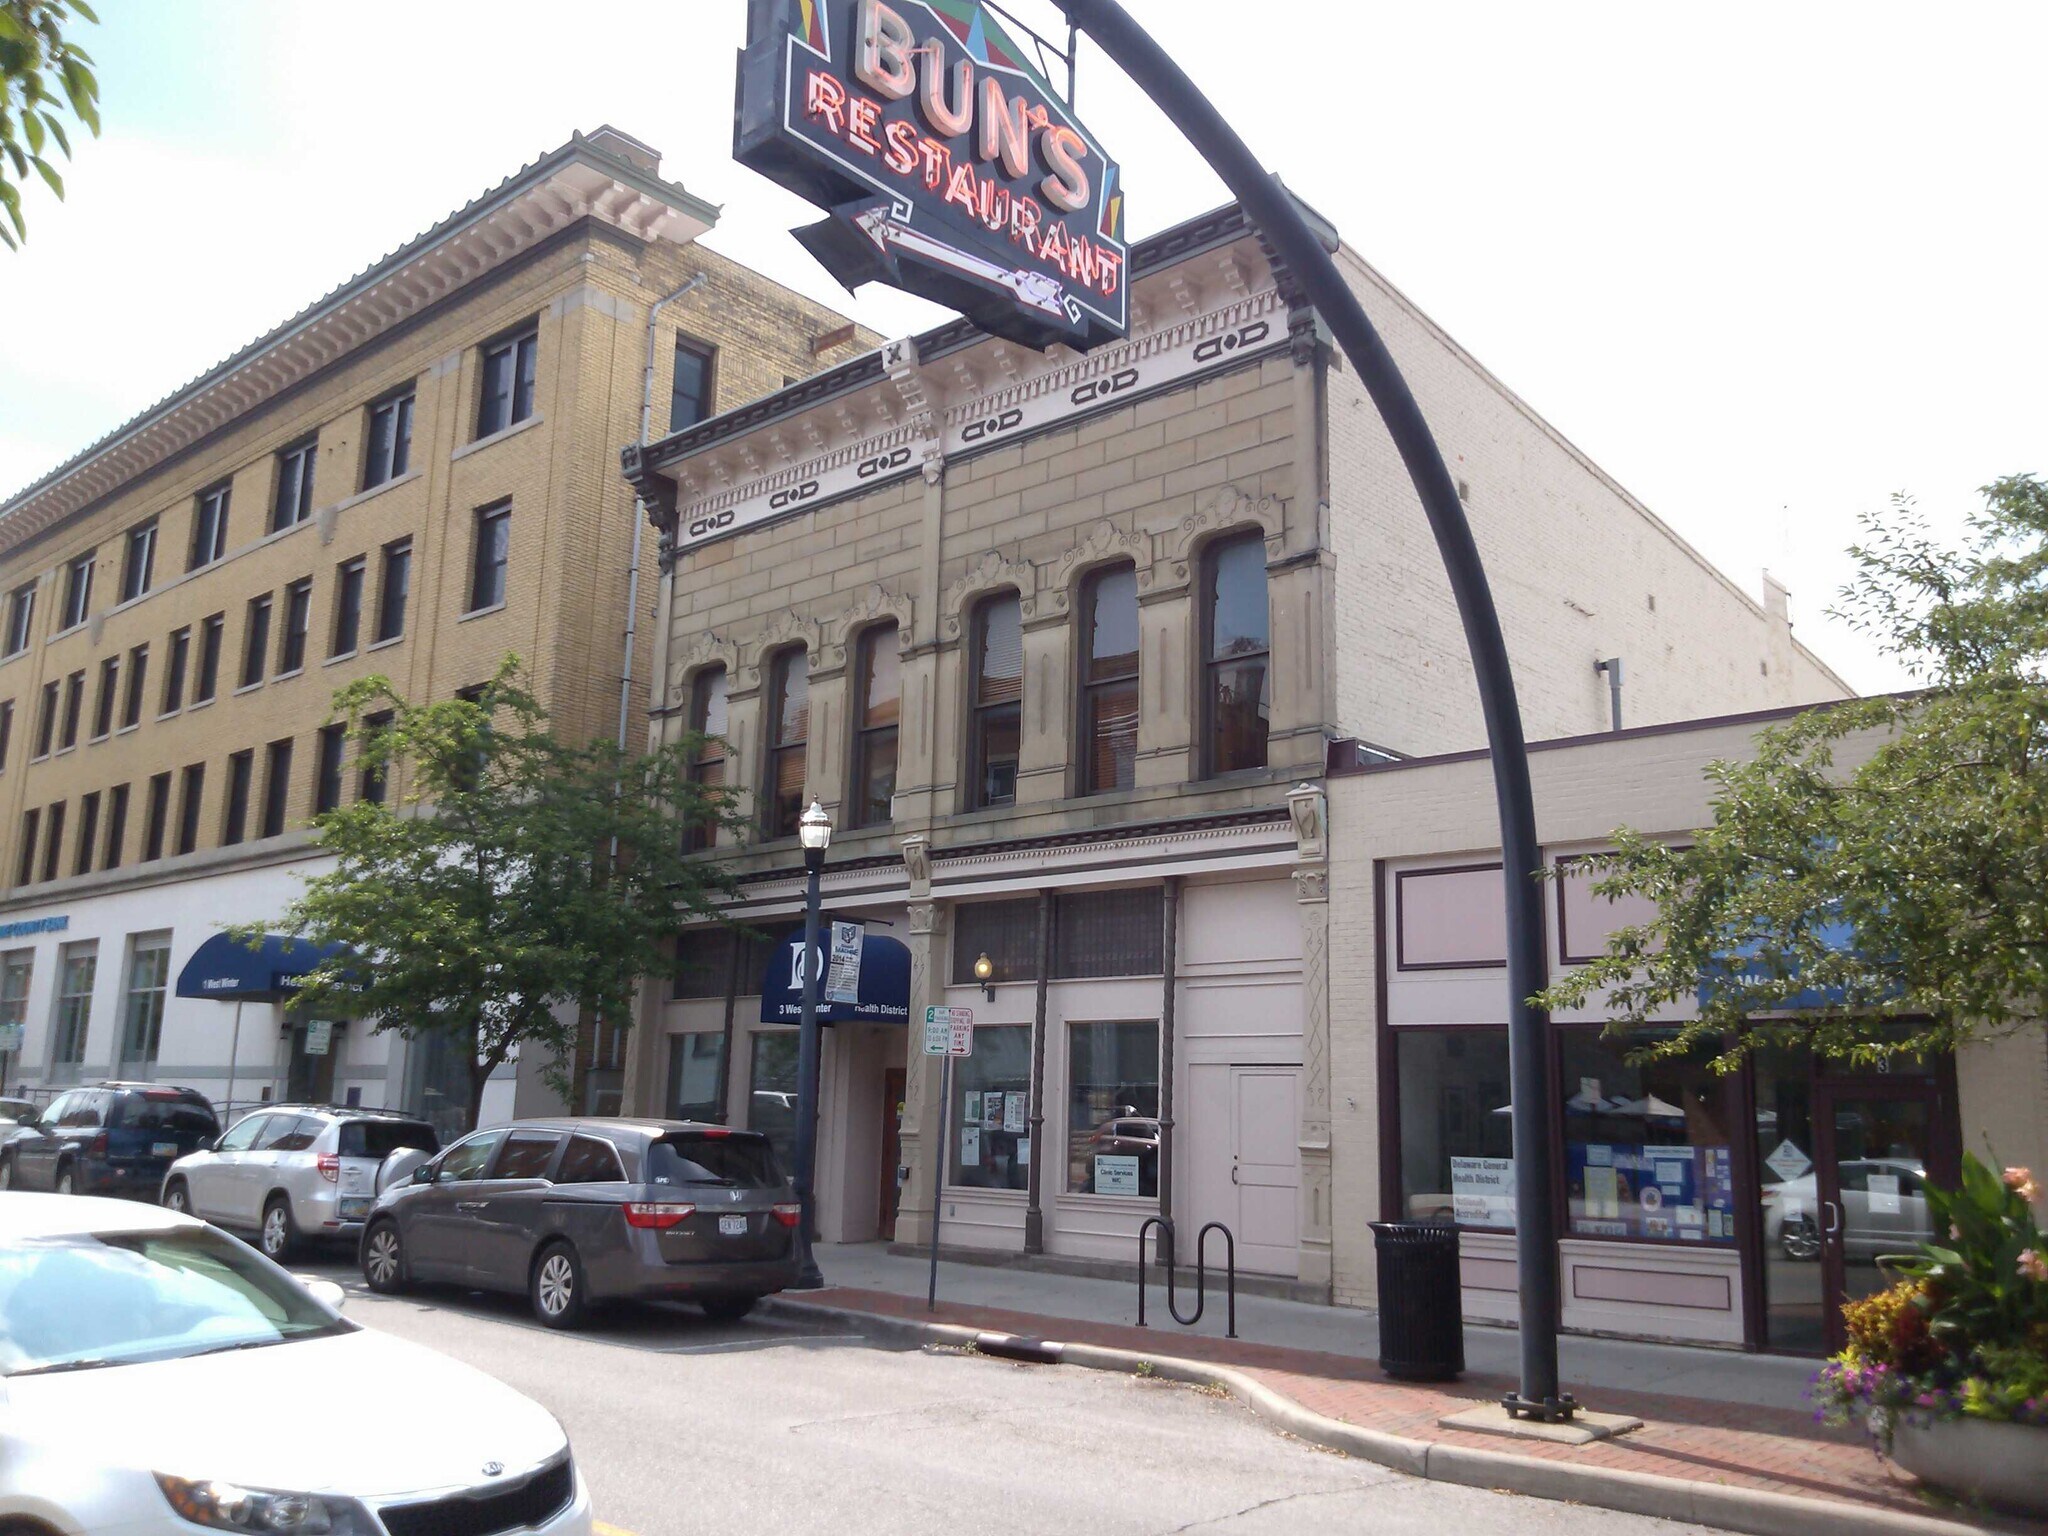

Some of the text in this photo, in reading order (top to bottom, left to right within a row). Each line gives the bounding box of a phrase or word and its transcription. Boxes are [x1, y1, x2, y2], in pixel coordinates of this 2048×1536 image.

[855, 0, 1091, 212] BUN'S
[805, 71, 1123, 297] RESTAURANT
[832, 954, 845, 963] 2014
[207, 978, 222, 989] West
[222, 977, 240, 989] Winter
[779, 1004, 784, 1014] 3
[785, 1004, 802, 1014] Wes
[880, 1004, 908, 1015] District
[928, 1010, 934, 1020] 2
[1453, 1159, 1508, 1170] Delaware General
[1454, 1174, 1500, 1185] Health District
